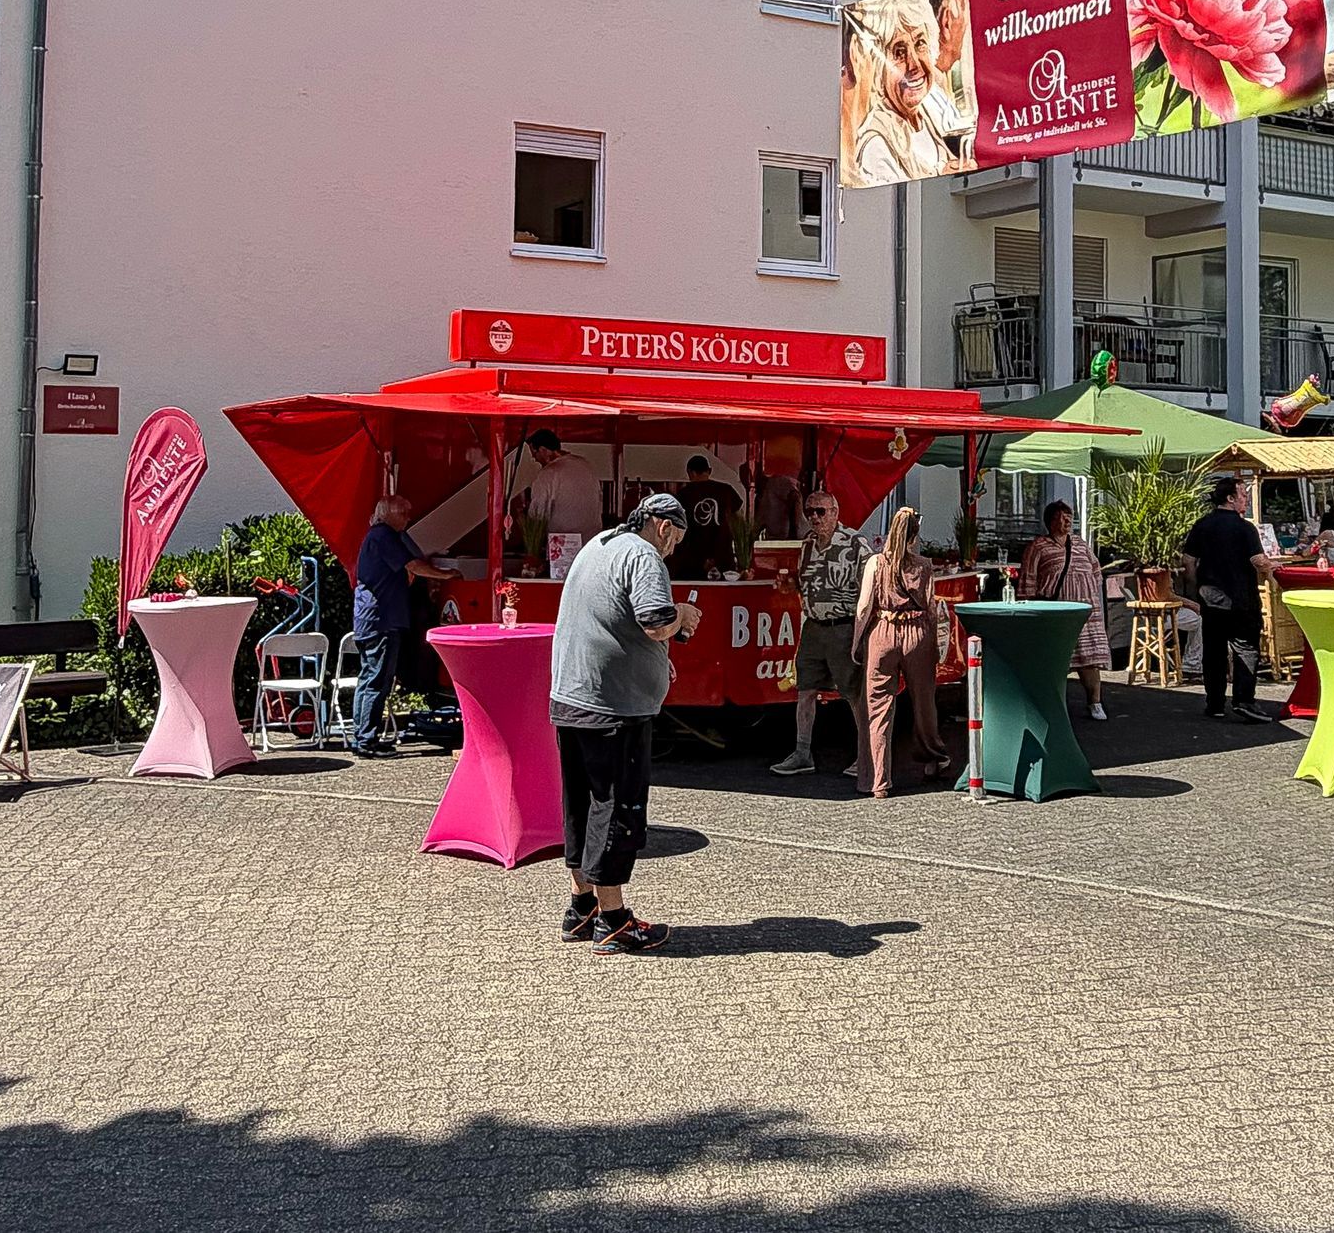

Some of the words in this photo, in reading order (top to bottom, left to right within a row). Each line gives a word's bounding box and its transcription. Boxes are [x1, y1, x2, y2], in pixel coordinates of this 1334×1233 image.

[1071, 75, 1116, 94] RESIDENZ
[991, 87, 1118, 132] AMBIENTE
[580, 326, 685, 361] PETERS
[690, 333, 789, 367] KÖLSCH
[136, 437, 187, 526] AMBIENTE
[732, 606, 795, 647] BRA
[756, 660, 793, 679] au
